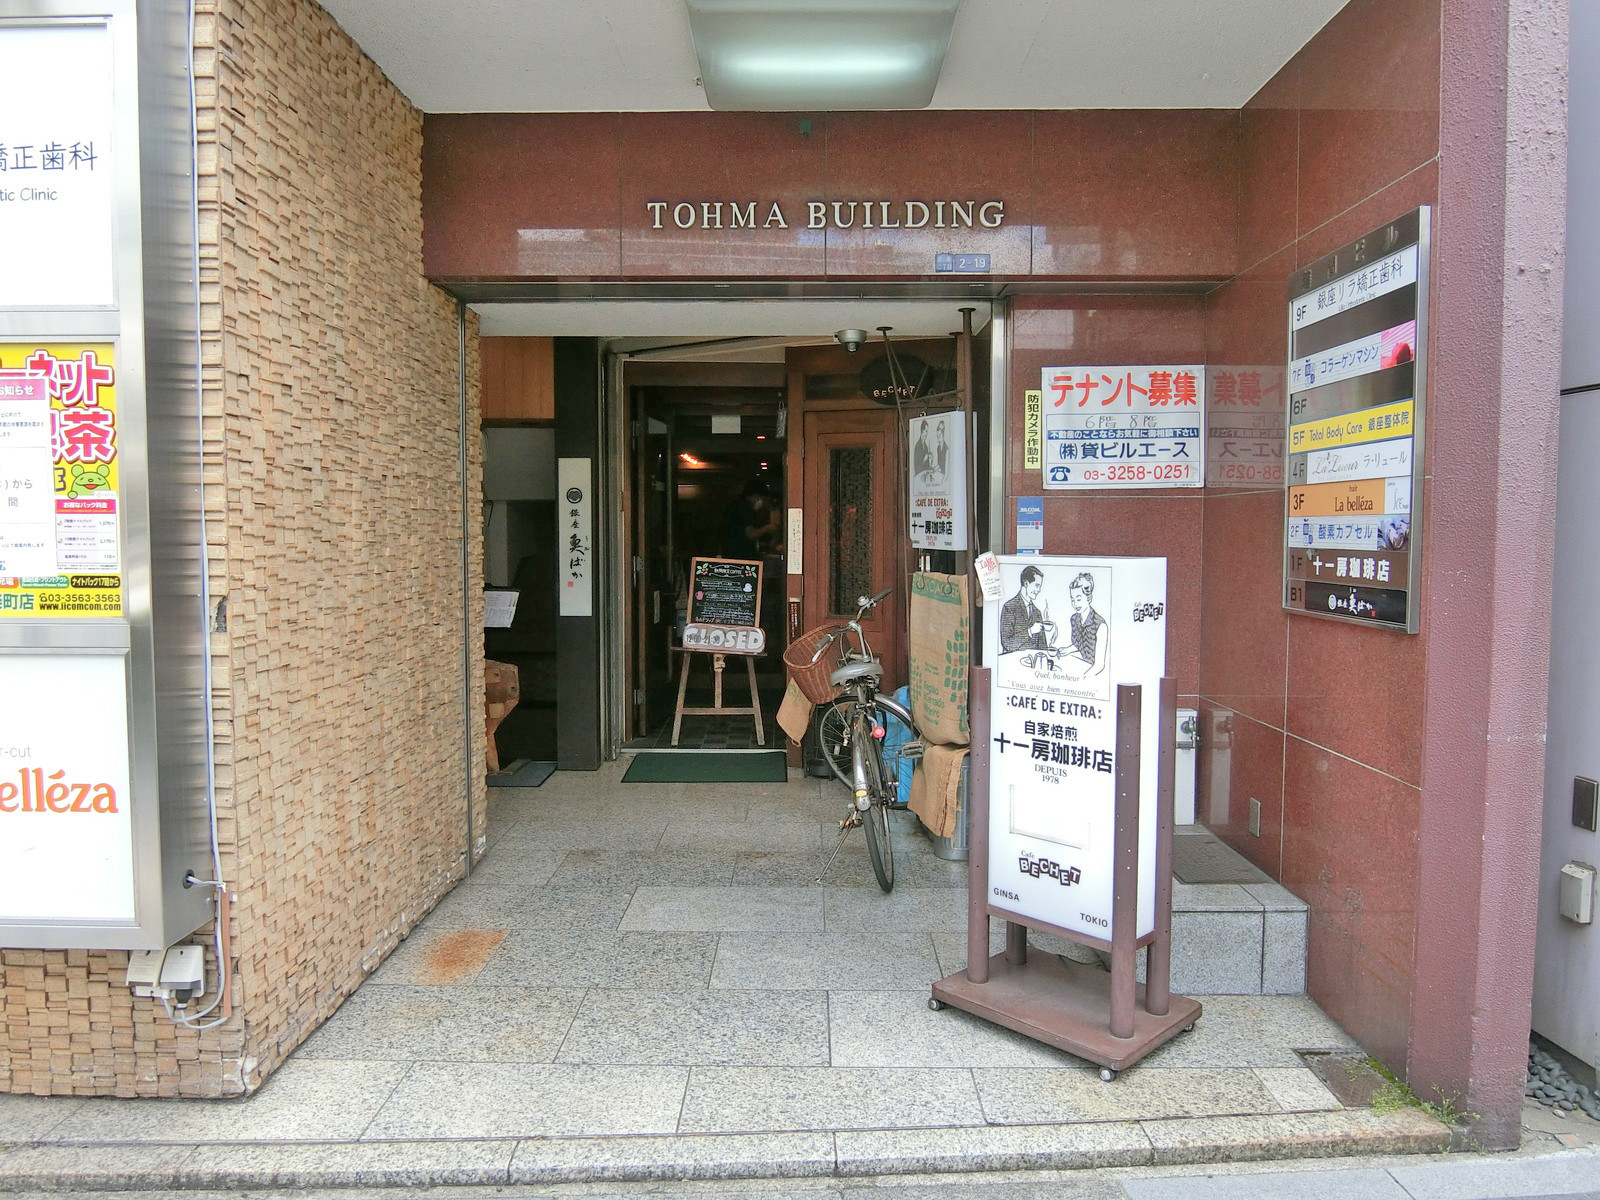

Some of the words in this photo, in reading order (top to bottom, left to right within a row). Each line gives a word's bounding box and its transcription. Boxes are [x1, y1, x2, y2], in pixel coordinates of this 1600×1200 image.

[20, 187, 58, 201] Clinic
[647, 201, 788, 229] TOHMA
[807, 200, 1005, 230] BUILDING
[958, 258, 986, 269] 2-19
[1316, 256, 1403, 311] 銀座リラ矯正歯科
[1296, 305, 1307, 321] 9F
[1320, 345, 1379, 374] コラーゲンマシン
[1292, 367, 1301, 382] 7F
[1050, 371, 1197, 407] テナント募集
[1293, 398, 1307, 415] 6F
[1027, 394, 1040, 465] 防犯カメラ作動中
[1085, 415, 1117, 429] 6階
[1129, 414, 1158, 428] 8階
[1367, 411, 1410, 431] 銀座整体院
[1293, 430, 1305, 446] 5F
[1309, 428, 1325, 442] Total
[1326, 425, 1344, 443] Body
[1346, 422, 1363, 435] Care
[1084, 464, 1190, 481] 03-3258-0251
[1292, 463, 1304, 478] 4F
[1293, 493, 1304, 510] 3F
[1334, 497, 1344, 512] La
[1347, 495, 1373, 512] belléza
[912, 519, 953, 535] 十一房珈琲店
[1290, 525, 1299, 538] 2F
[1318, 524, 1373, 540] 酸素カプセル
[1291, 556, 1303, 571] 1F
[1313, 555, 1390, 583] 十一房珈琲店
[0, 593, 35, 611] 町店
[48, 593, 121, 603] 03-3563-3563
[1291, 587, 1303, 602] B1
[39, 602, 121, 611] www.iicomcom.com
[1133, 602, 1164, 623] BECHET
[685, 627, 764, 649] CLOSED
[1041, 699, 1055, 713] DE
[1024, 720, 1078, 742] 自家焙煎
[993, 732, 1113, 774] 十一房珈琲店
[1034, 764, 1068, 778] DEPUIS
[1042, 774, 1060, 785] 1978
[0, 767, 118, 814] elléza
[1018, 857, 1082, 887] BECHET
[993, 887, 1021, 902] GINSA
[1079, 912, 1109, 928] TOKIO
